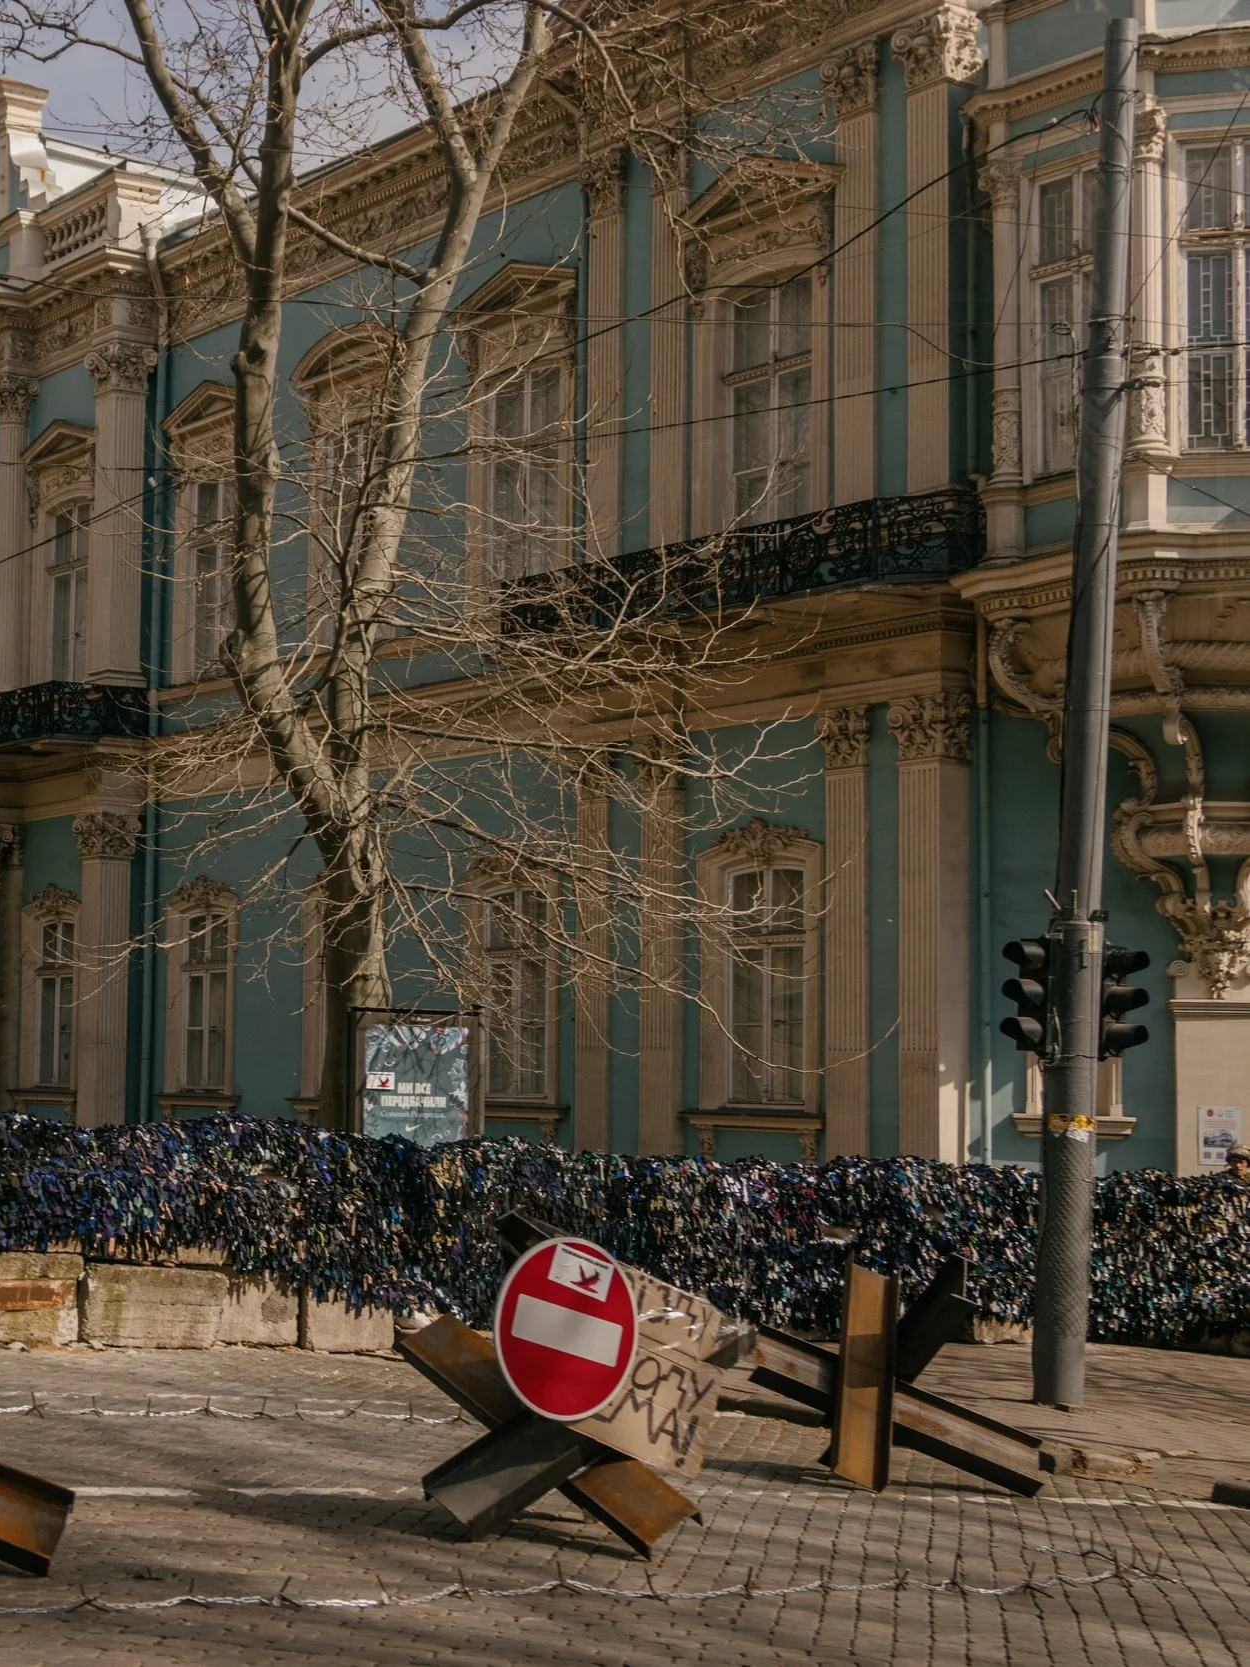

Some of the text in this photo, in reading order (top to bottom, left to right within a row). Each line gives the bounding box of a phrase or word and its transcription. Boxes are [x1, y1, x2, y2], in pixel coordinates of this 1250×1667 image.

[381, 1095, 447, 1109] ПЕРЕДБАЧИЛИ
[397, 1082, 431, 1094] МИ ВСЕ
[626, 1271, 714, 1341] ЇЗДУ
[631, 1356, 715, 1413] ОДУ
